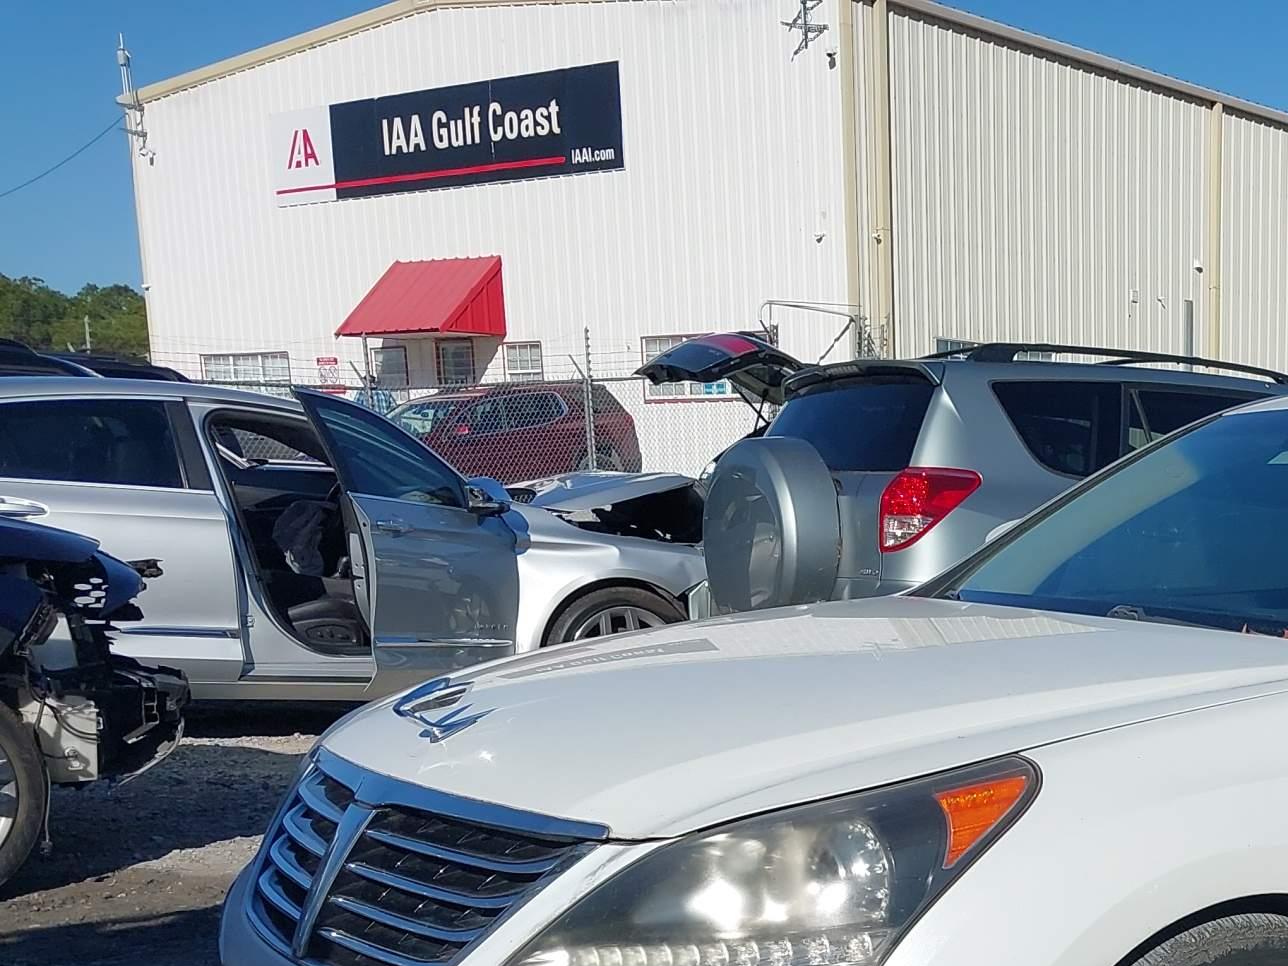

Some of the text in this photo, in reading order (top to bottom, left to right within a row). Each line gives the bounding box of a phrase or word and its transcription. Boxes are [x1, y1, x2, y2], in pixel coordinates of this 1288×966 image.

[382, 98, 561, 155] IAA Gulf Coast
[571, 146, 615, 165] IAAI.com
